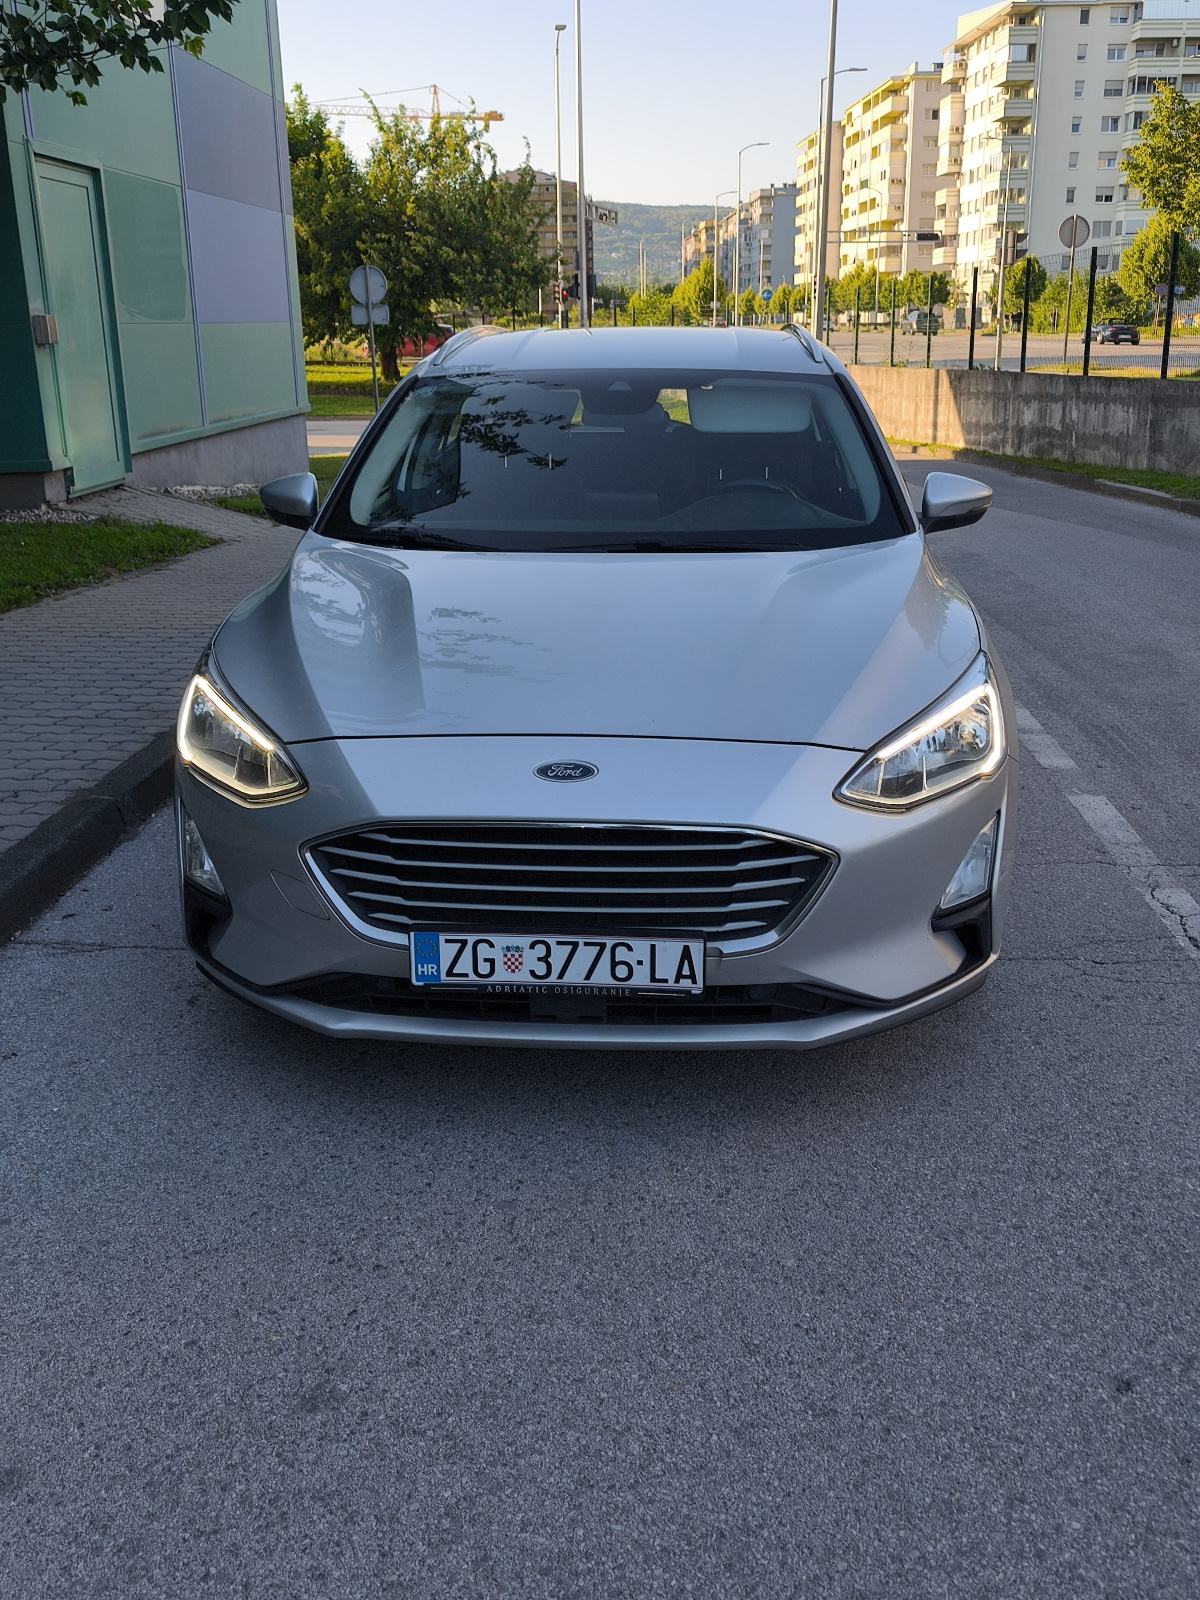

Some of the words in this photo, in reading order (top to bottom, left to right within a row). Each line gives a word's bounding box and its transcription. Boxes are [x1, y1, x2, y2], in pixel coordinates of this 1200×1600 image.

[547, 764, 583, 777] Ford
[444, 938, 496, 978] ZG
[528, 939, 698, 985] 3776-LA
[417, 963, 438, 976] HR
[486, 985, 548, 994] ADRIATIC
[554, 986, 632, 997] OSIGURANJE
